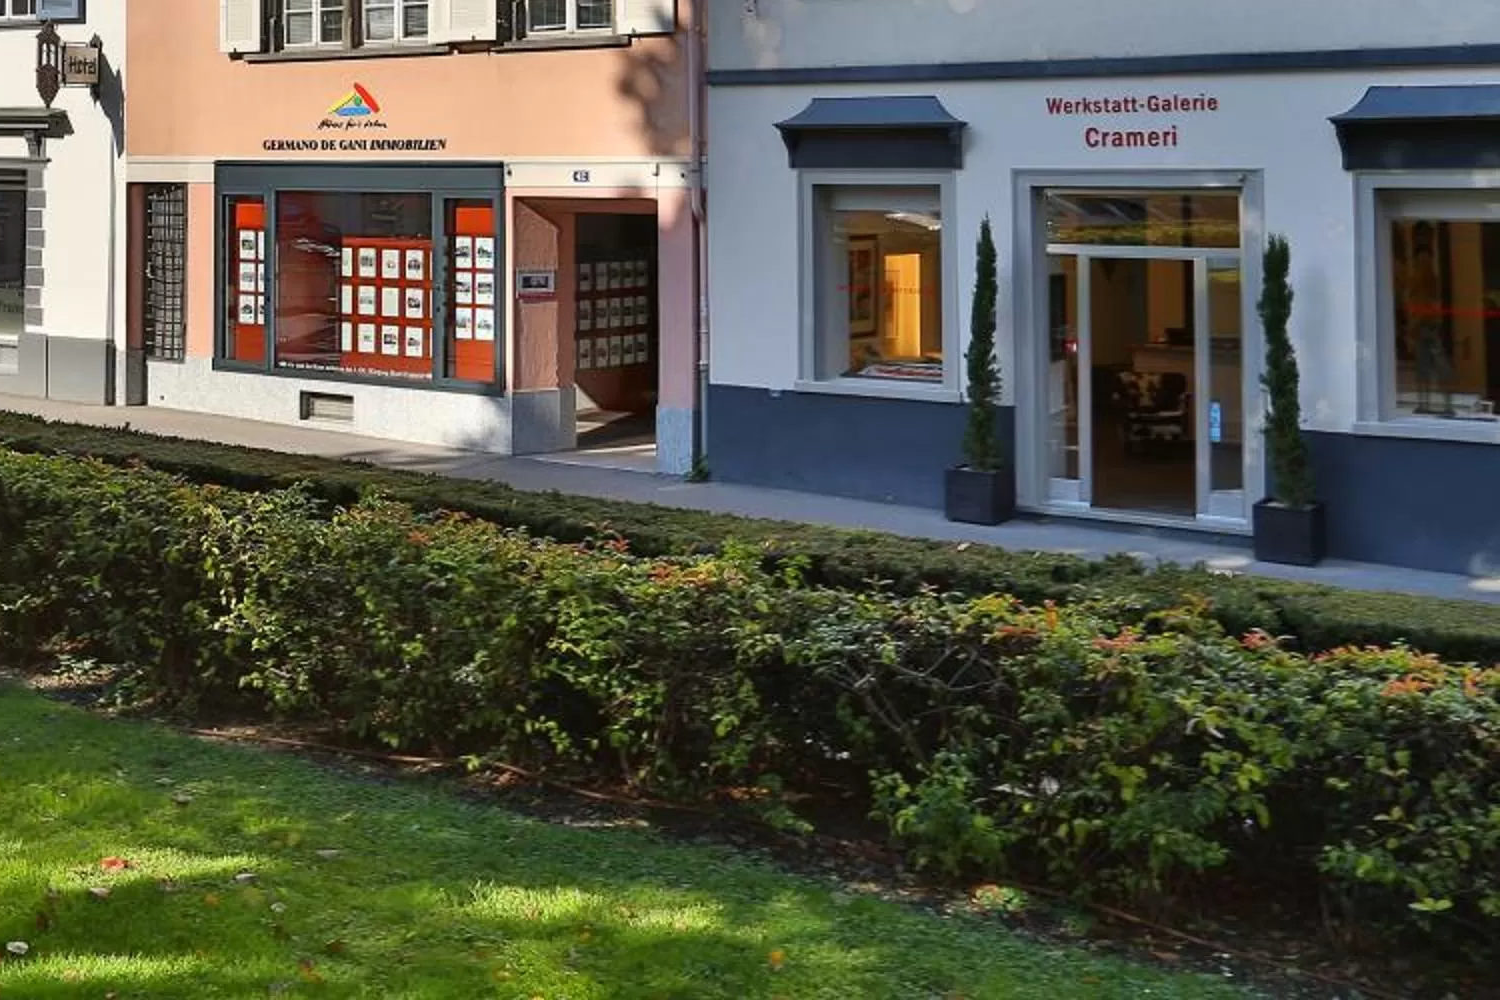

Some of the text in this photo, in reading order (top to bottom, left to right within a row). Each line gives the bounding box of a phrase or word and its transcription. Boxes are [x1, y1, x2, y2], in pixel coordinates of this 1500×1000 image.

[68, 56, 97, 75] Hotel
[1046, 93, 1219, 115] Werkstatt-Galerie
[263, 139, 447, 151] GERMANO DE GANI IMMOBILIEN
[1085, 125, 1178, 148] Crameri
